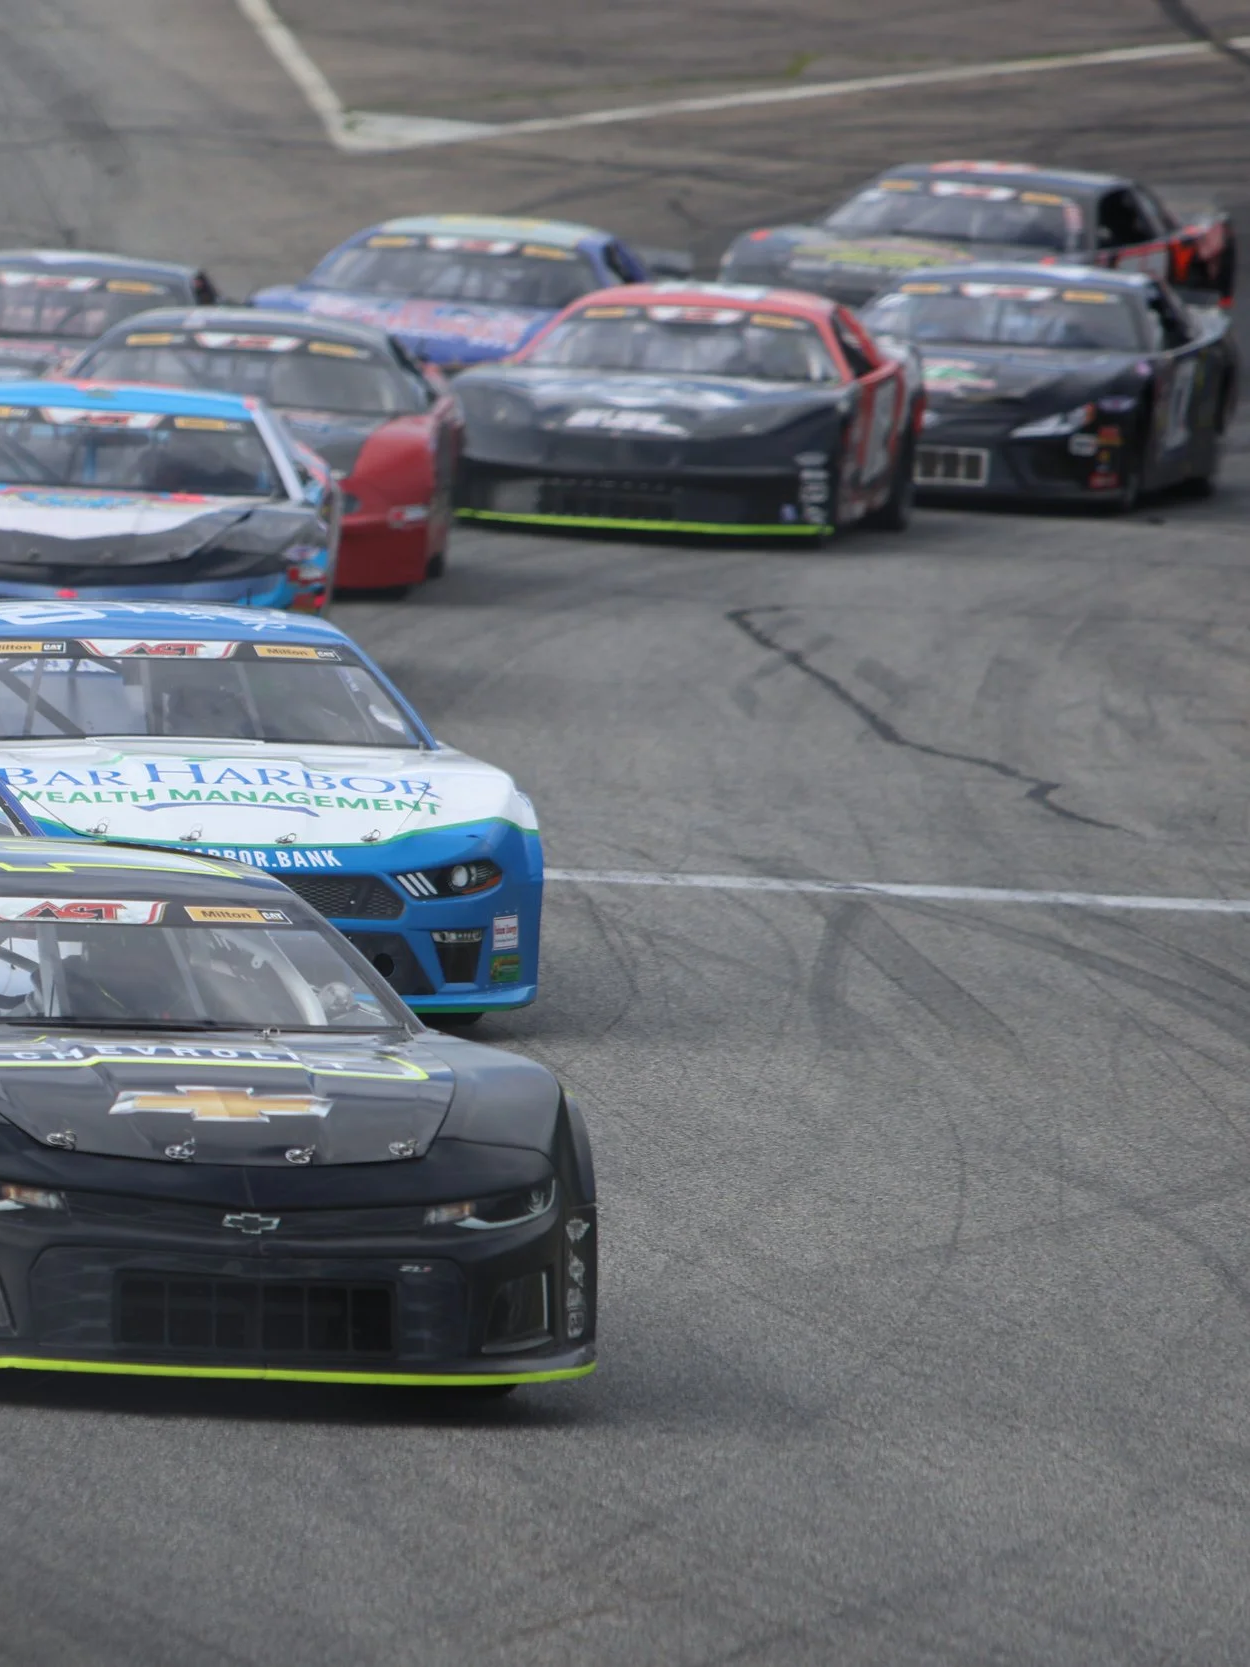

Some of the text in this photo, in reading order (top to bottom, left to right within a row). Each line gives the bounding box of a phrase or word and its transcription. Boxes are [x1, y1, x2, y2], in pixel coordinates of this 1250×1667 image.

[115, 641, 206, 656] ACT
[266, 648, 310, 657] Milton
[144, 762, 444, 799] HARBOR
[17, 788, 440, 817] WEALTH MANAGEMENT
[17, 901, 127, 921] ACT
[201, 909, 286, 921] Milton CAT
